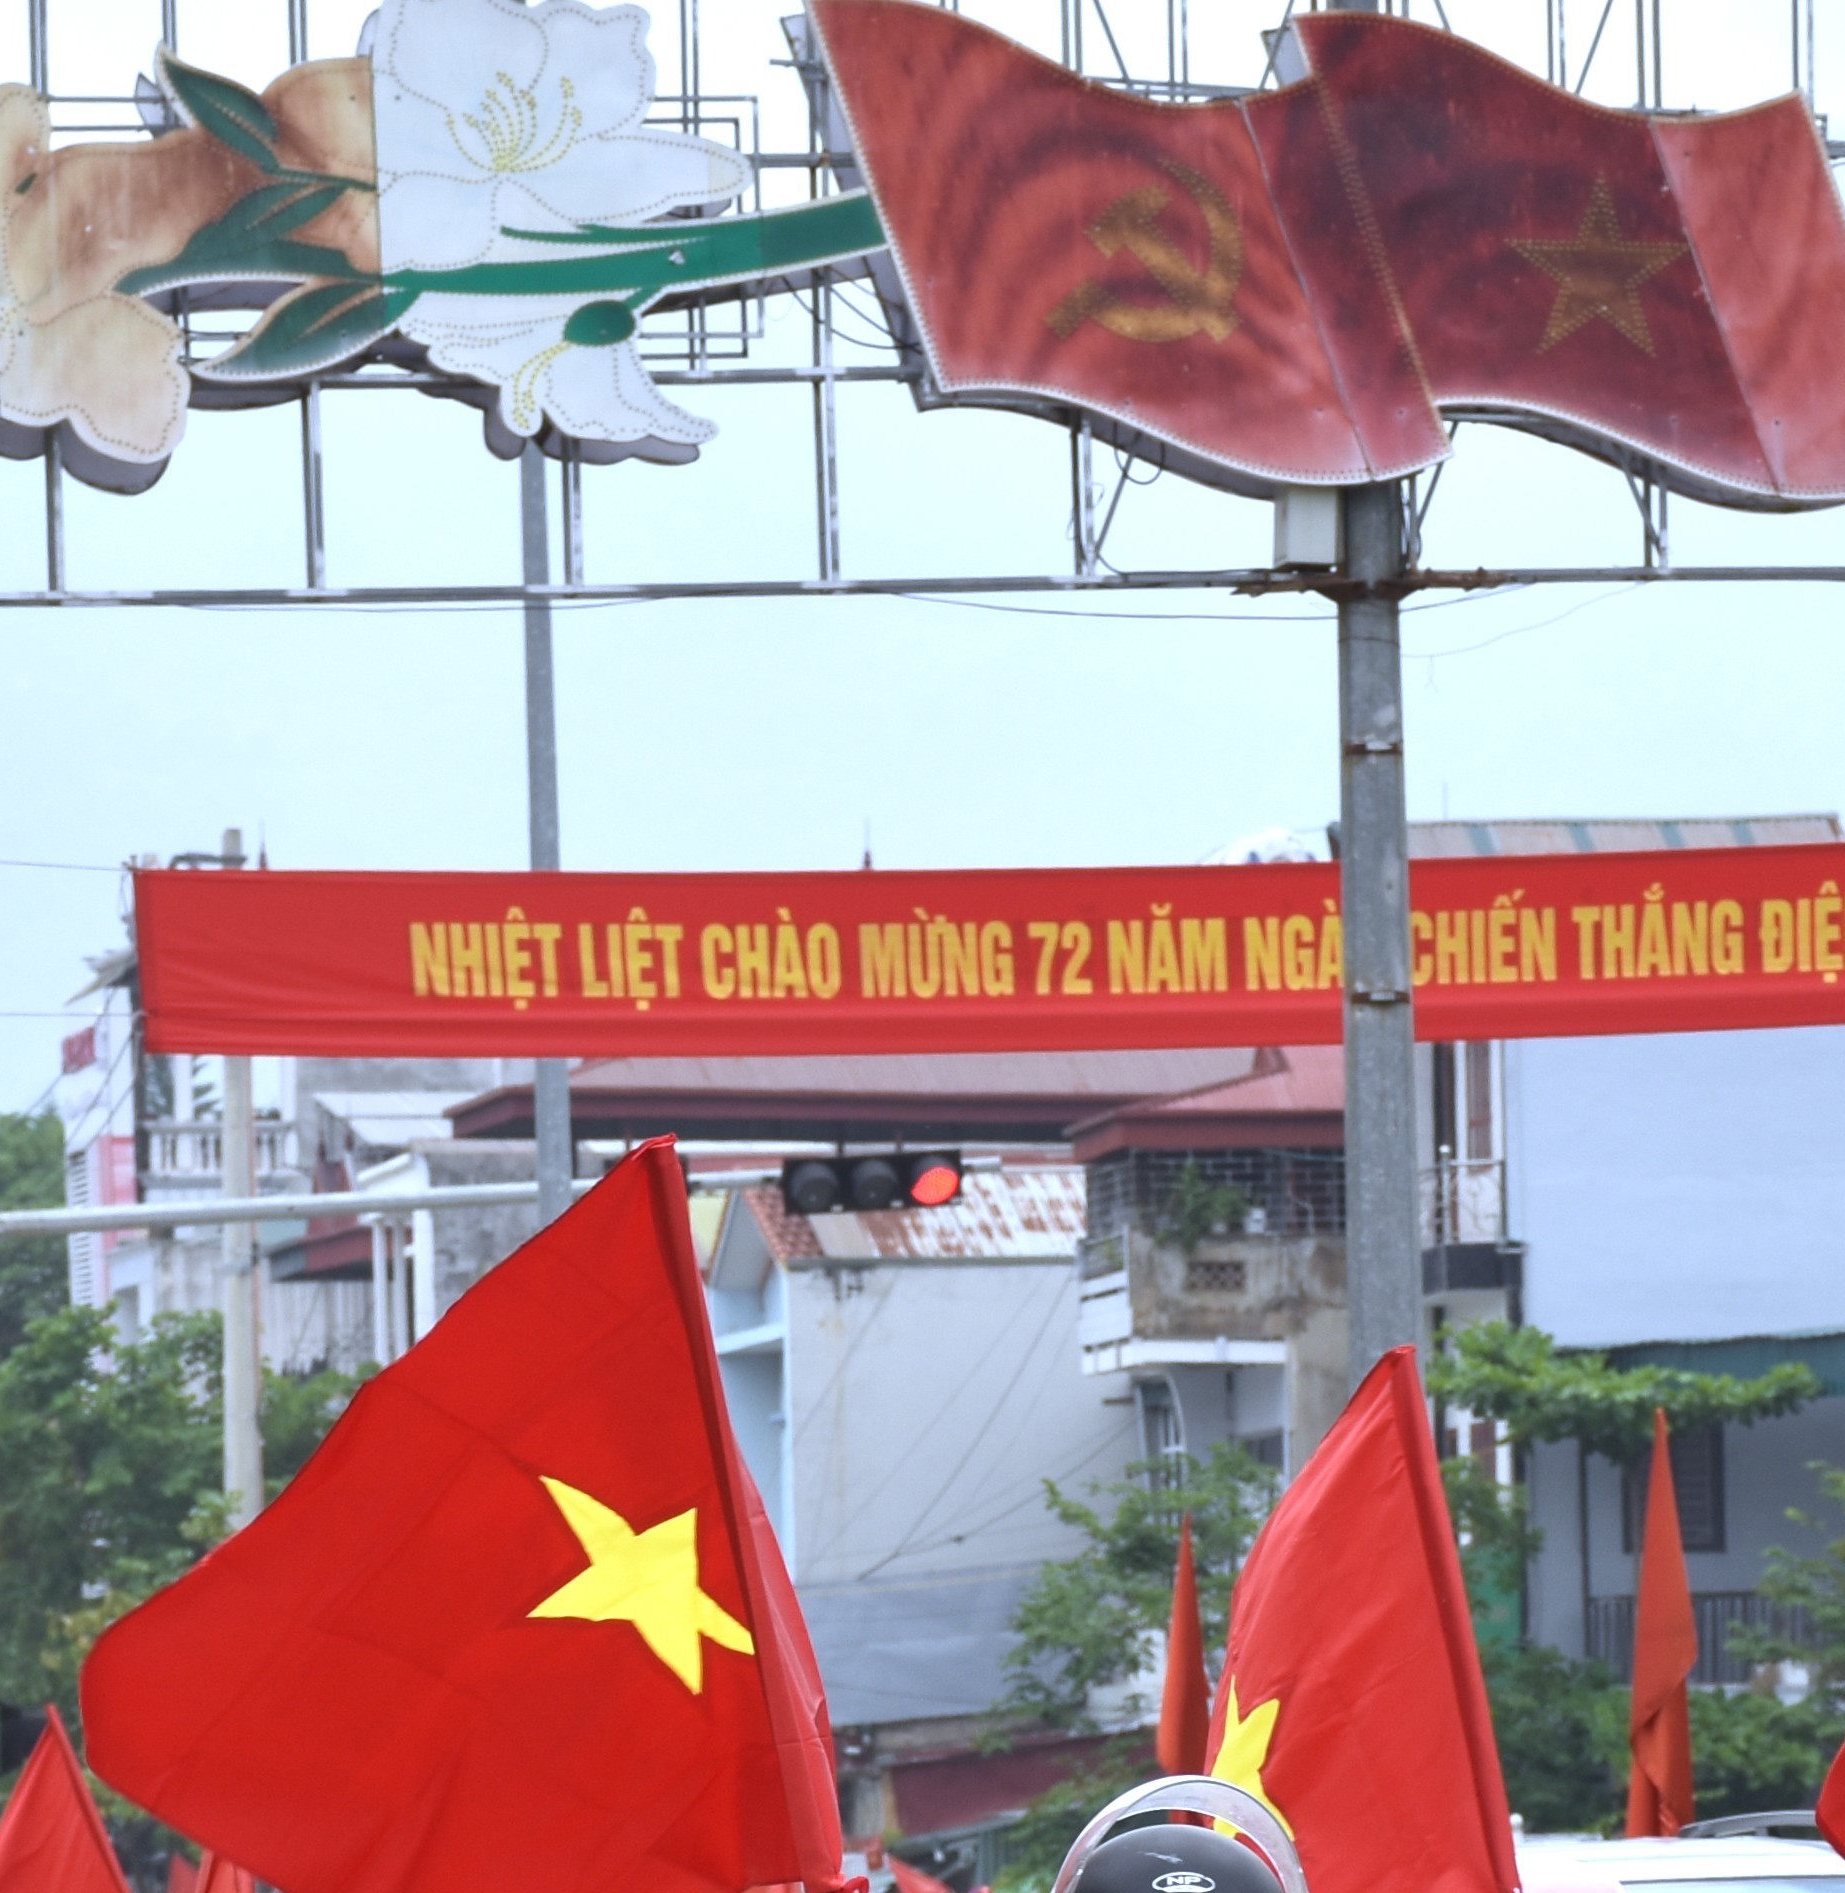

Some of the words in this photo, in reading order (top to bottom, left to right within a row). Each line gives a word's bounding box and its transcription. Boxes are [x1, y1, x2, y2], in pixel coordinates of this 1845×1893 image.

[409, 905, 563, 1010] NHIỆT
[578, 905, 684, 1011] LIỆT
[700, 906, 842, 1000] CHÀO
[859, 906, 1015, 999] MỪNG
[1028, 920, 1094, 996] 72
[1107, 902, 1229, 996] NĂM
[1243, 897, 1345, 992] NGÀ
[1408, 888, 1558, 987] CHIẾN
[1571, 880, 1745, 980] THẮNG
[1166, 1876, 1201, 1886] NP
